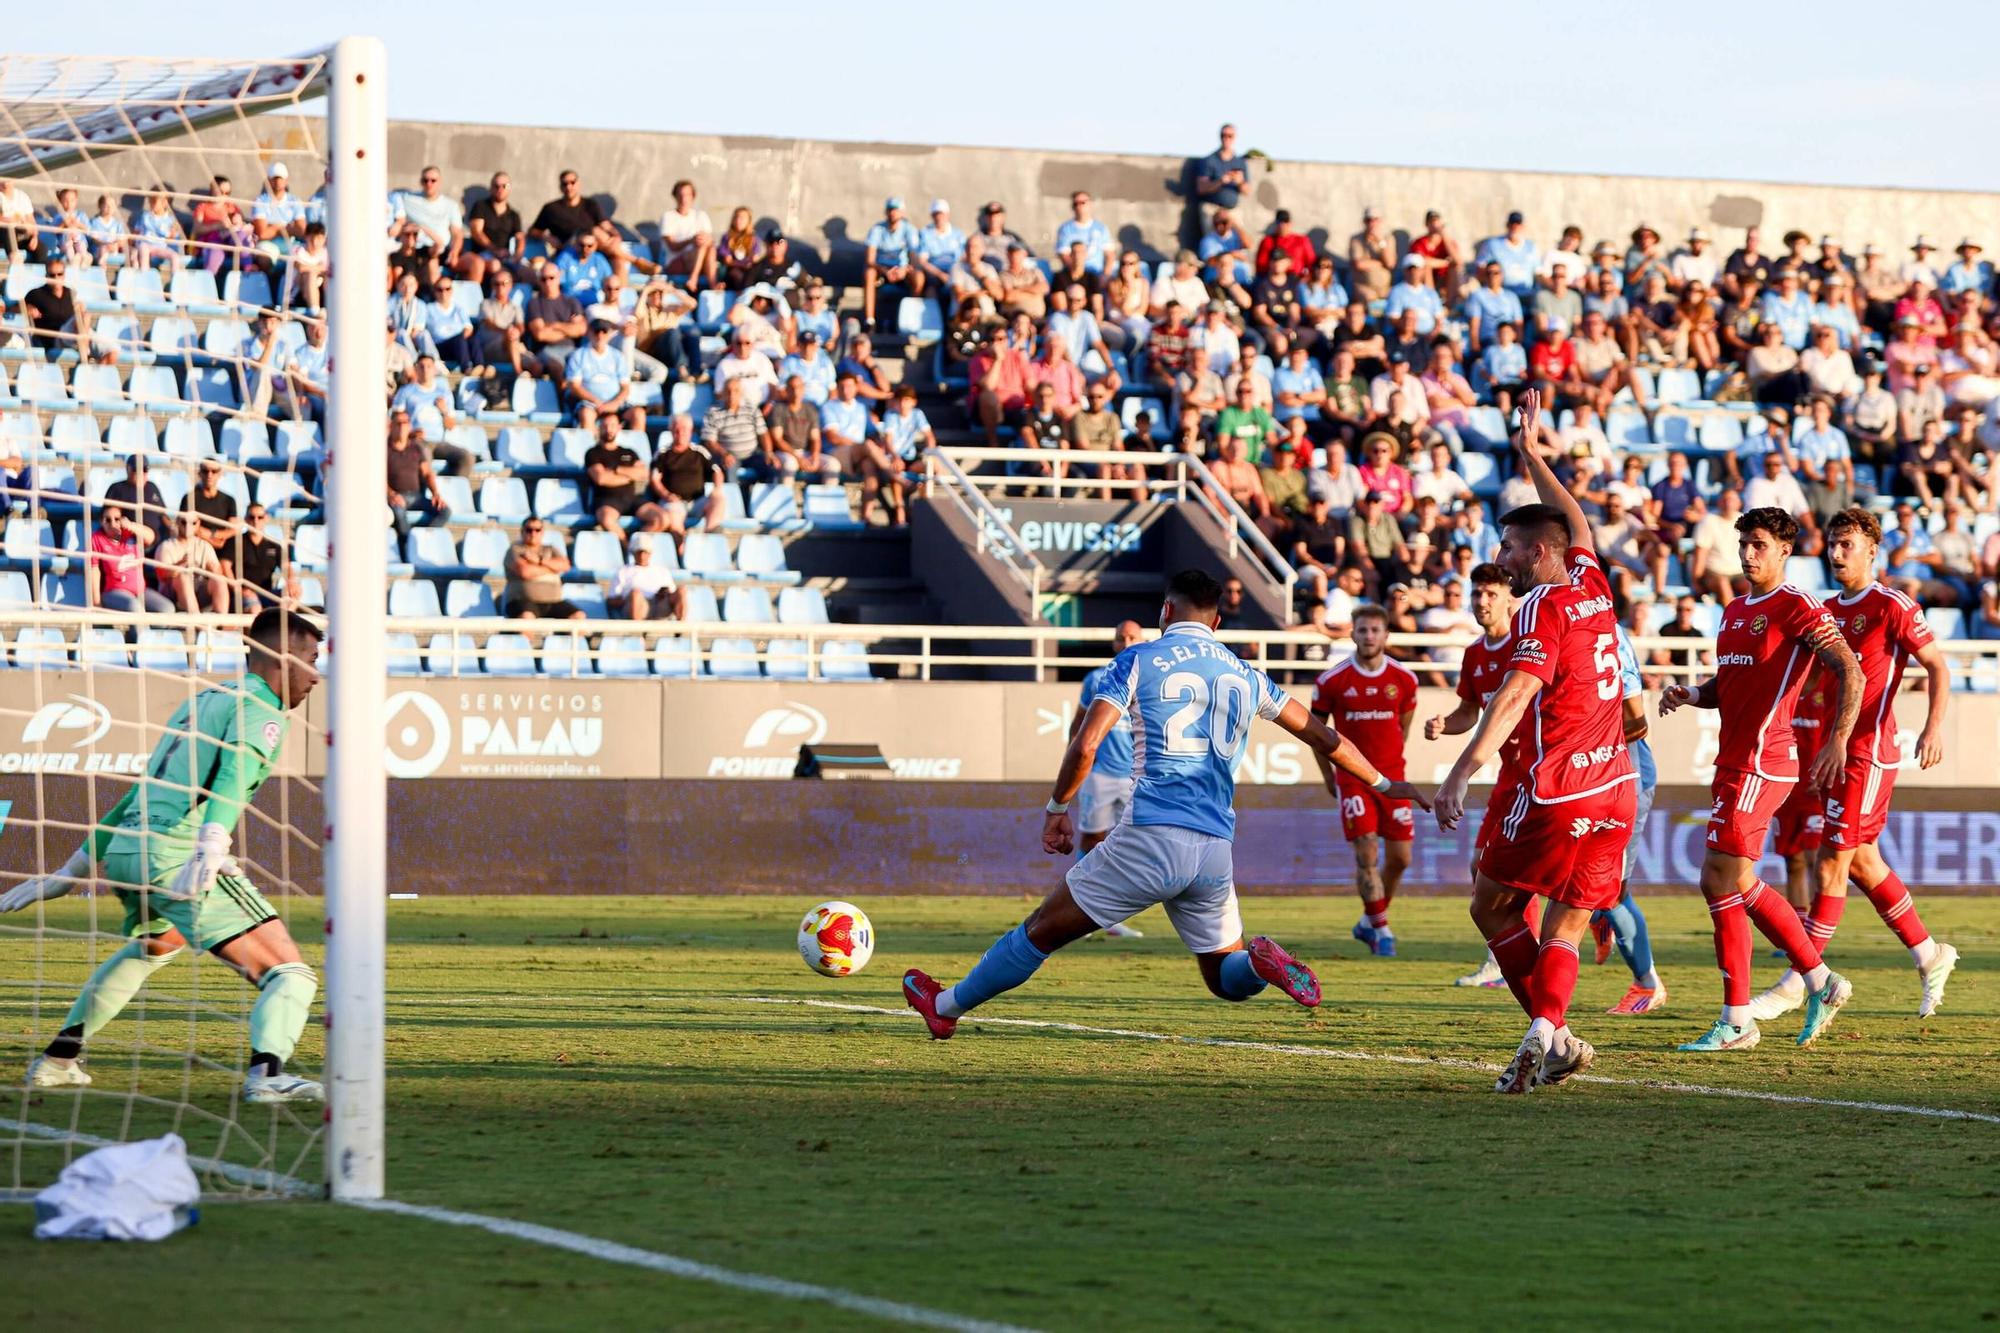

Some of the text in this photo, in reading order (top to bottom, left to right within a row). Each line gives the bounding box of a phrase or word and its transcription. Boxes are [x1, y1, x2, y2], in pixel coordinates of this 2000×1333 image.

[1593, 633, 1620, 701] 5
[460, 693, 603, 712] SERVICIOS
[1161, 672, 1250, 760] 20
[462, 716, 603, 757] PALAU
[0, 753, 152, 773] OWER ELEC
[708, 757, 800, 777] POWER
[889, 757, 962, 778] ONICS
[1344, 796, 1366, 817] 20
